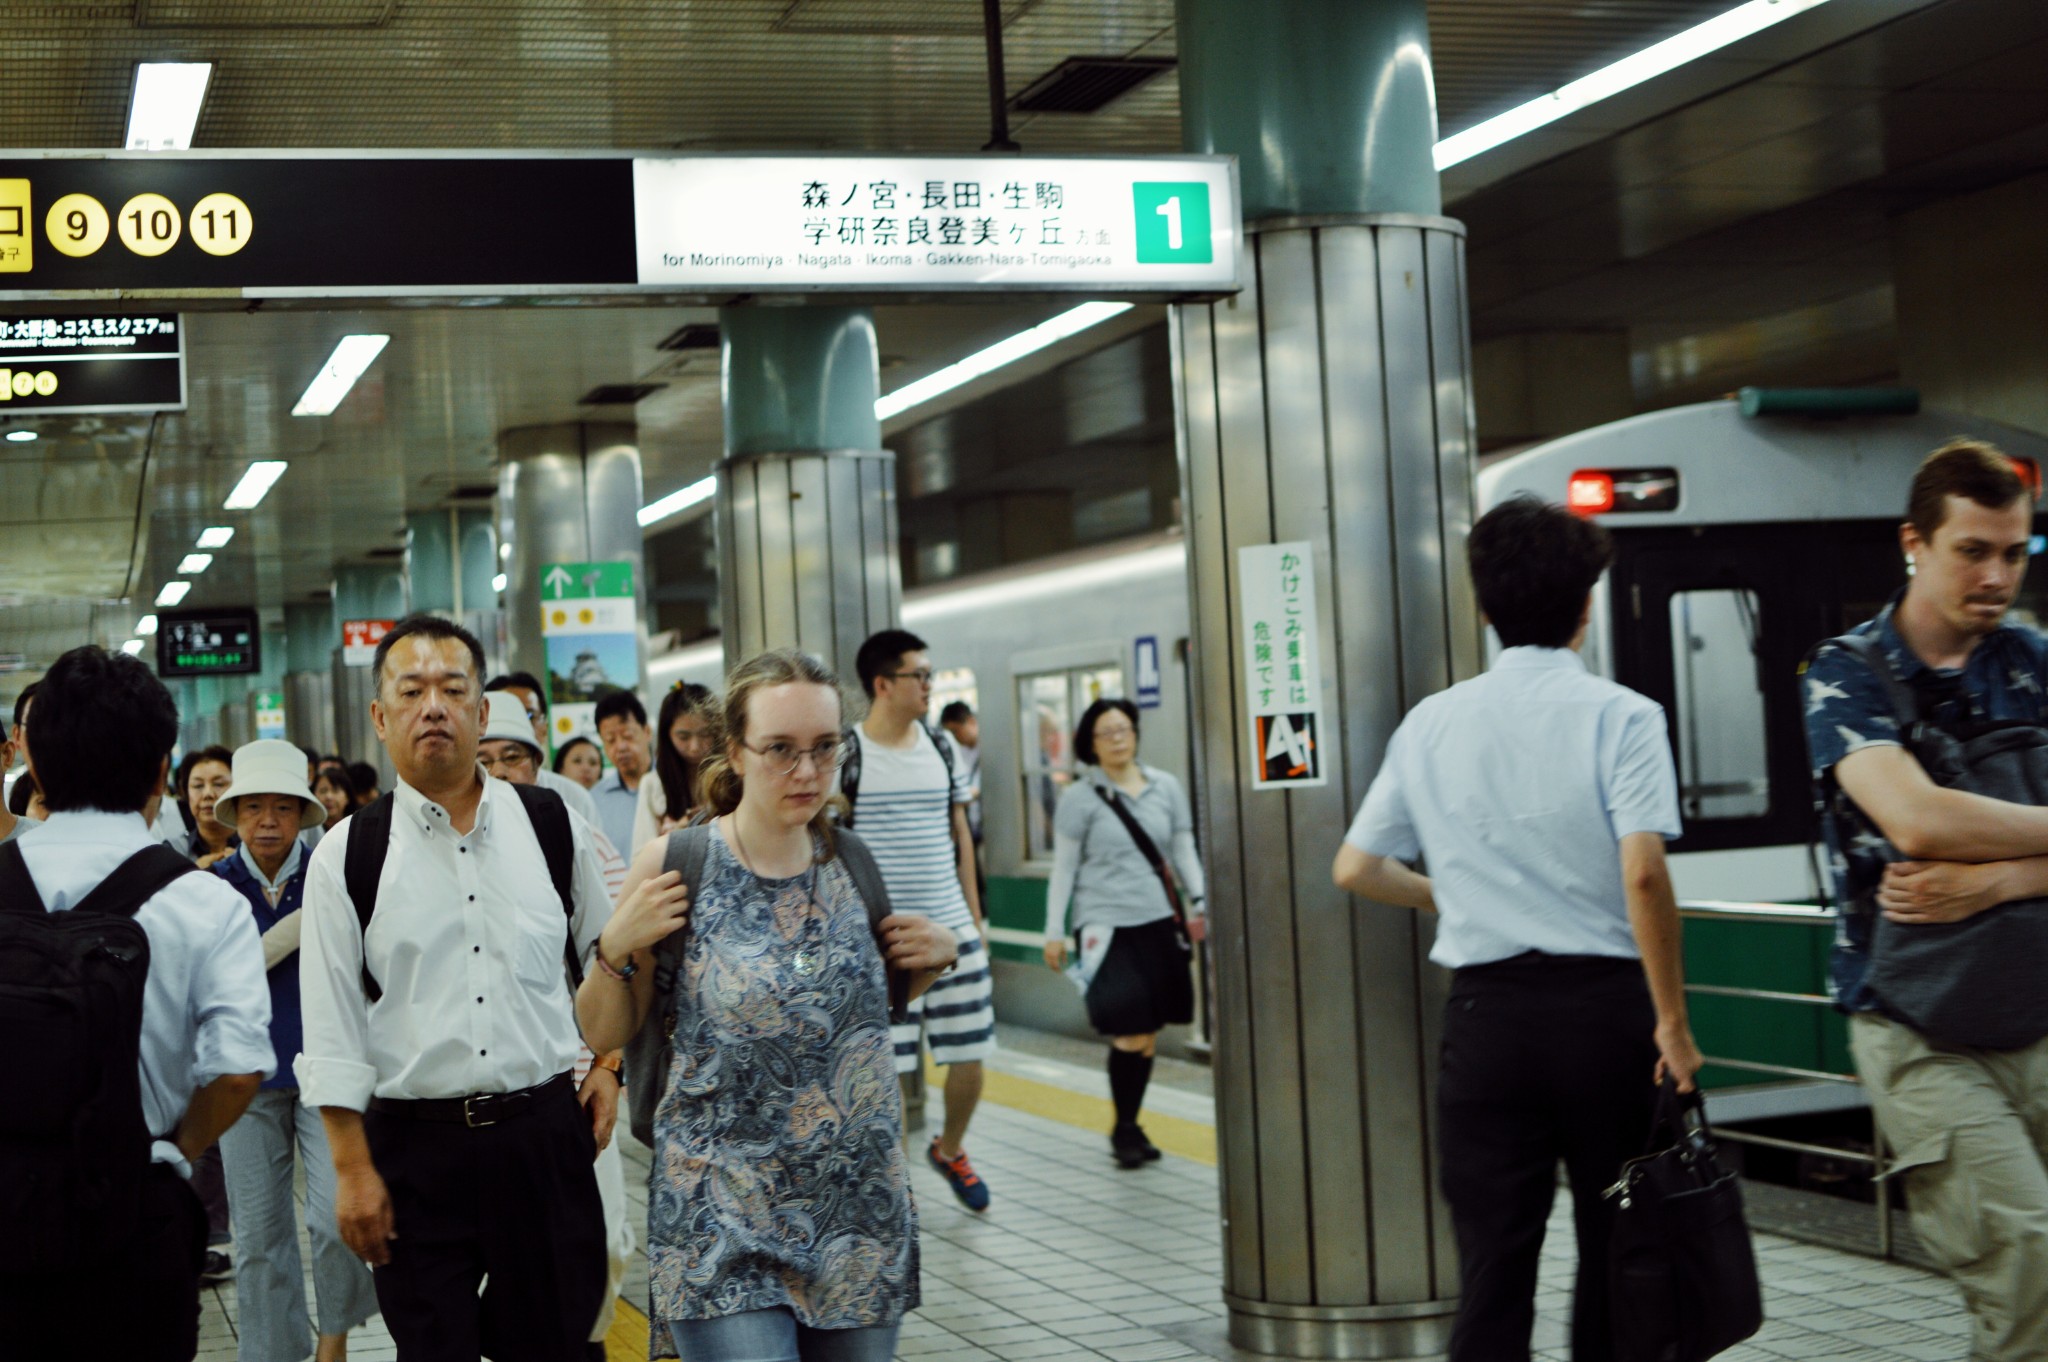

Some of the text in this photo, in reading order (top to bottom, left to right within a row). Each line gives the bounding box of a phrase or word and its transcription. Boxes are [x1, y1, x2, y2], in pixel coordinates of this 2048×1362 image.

[66, 209, 238, 241] 9 10 11
[1155, 196, 1183, 250] 1
[663, 253, 685, 267] for
[690, 253, 784, 269] Morinomiya
[798, 253, 852, 269] Nagata
[866, 253, 912, 267] Ikoma
[1281, 552, 1308, 705] かけこみ乗車は
[1253, 620, 1275, 707] 危険です
